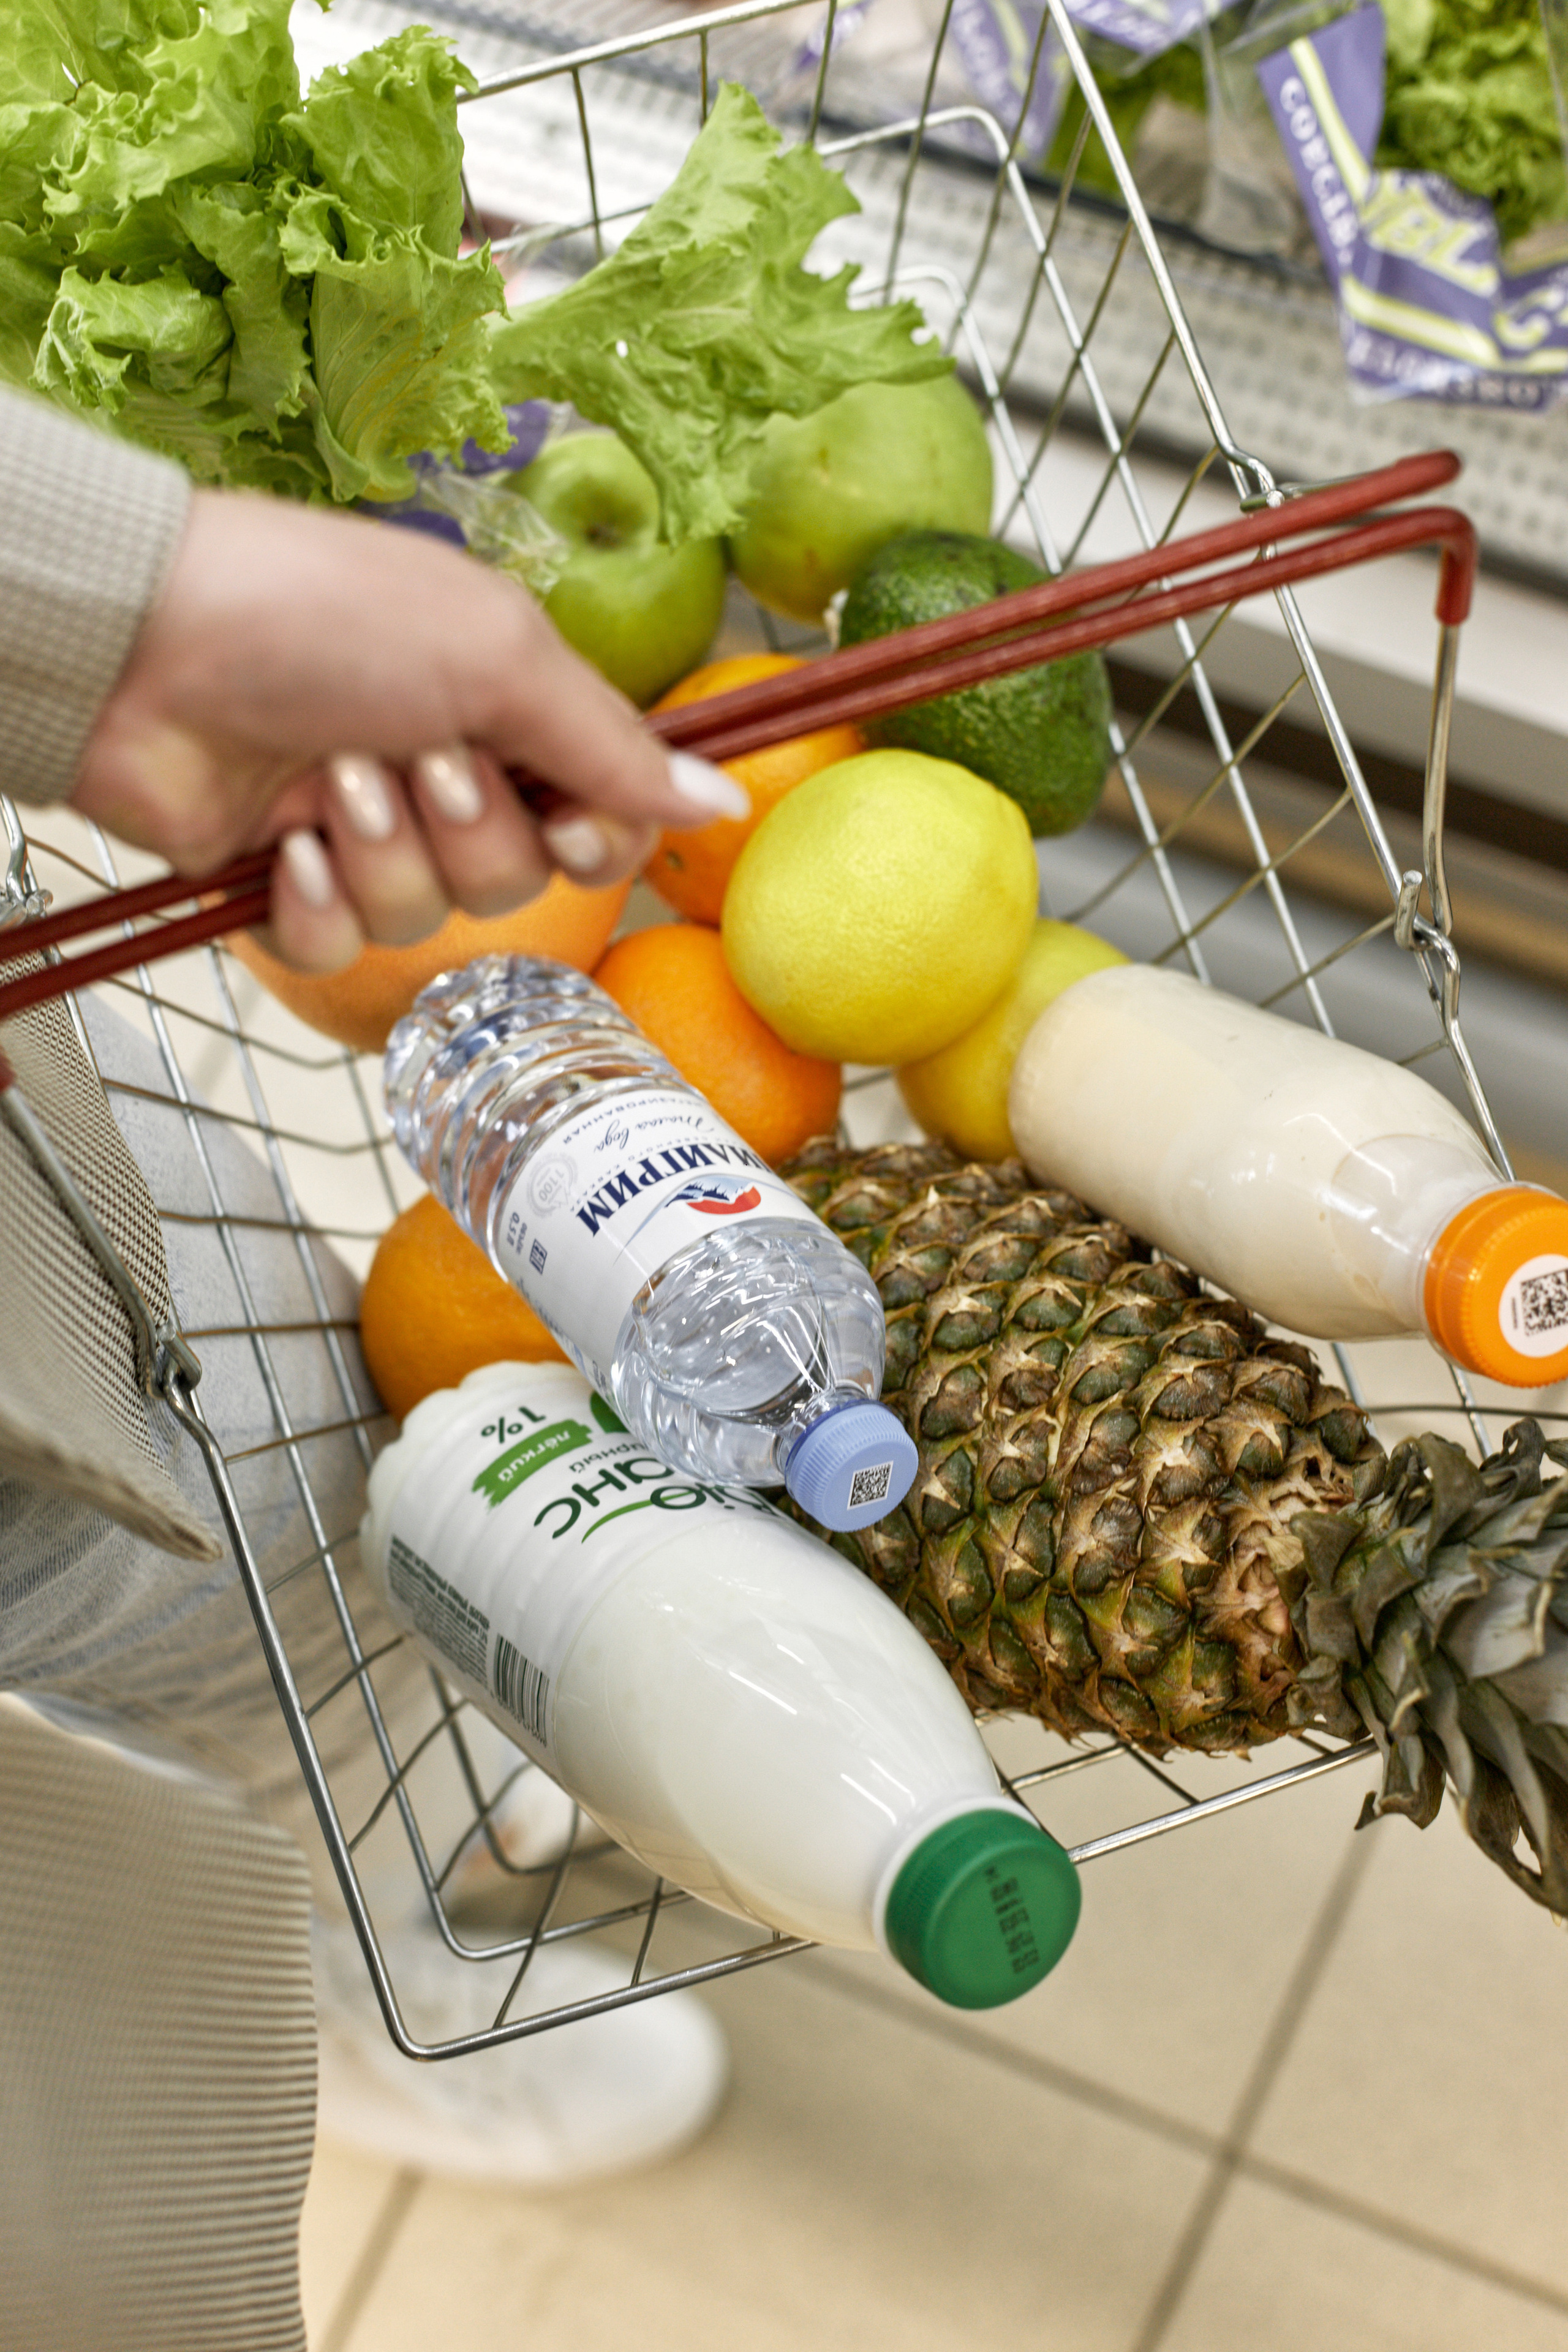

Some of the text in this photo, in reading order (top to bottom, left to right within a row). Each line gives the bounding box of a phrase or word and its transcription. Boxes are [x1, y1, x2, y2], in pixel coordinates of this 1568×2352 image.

[594, 1118, 630, 1153] вода
[538, 1167, 565, 1200] 1100
[497, 1429, 570, 1482] лёгкий
